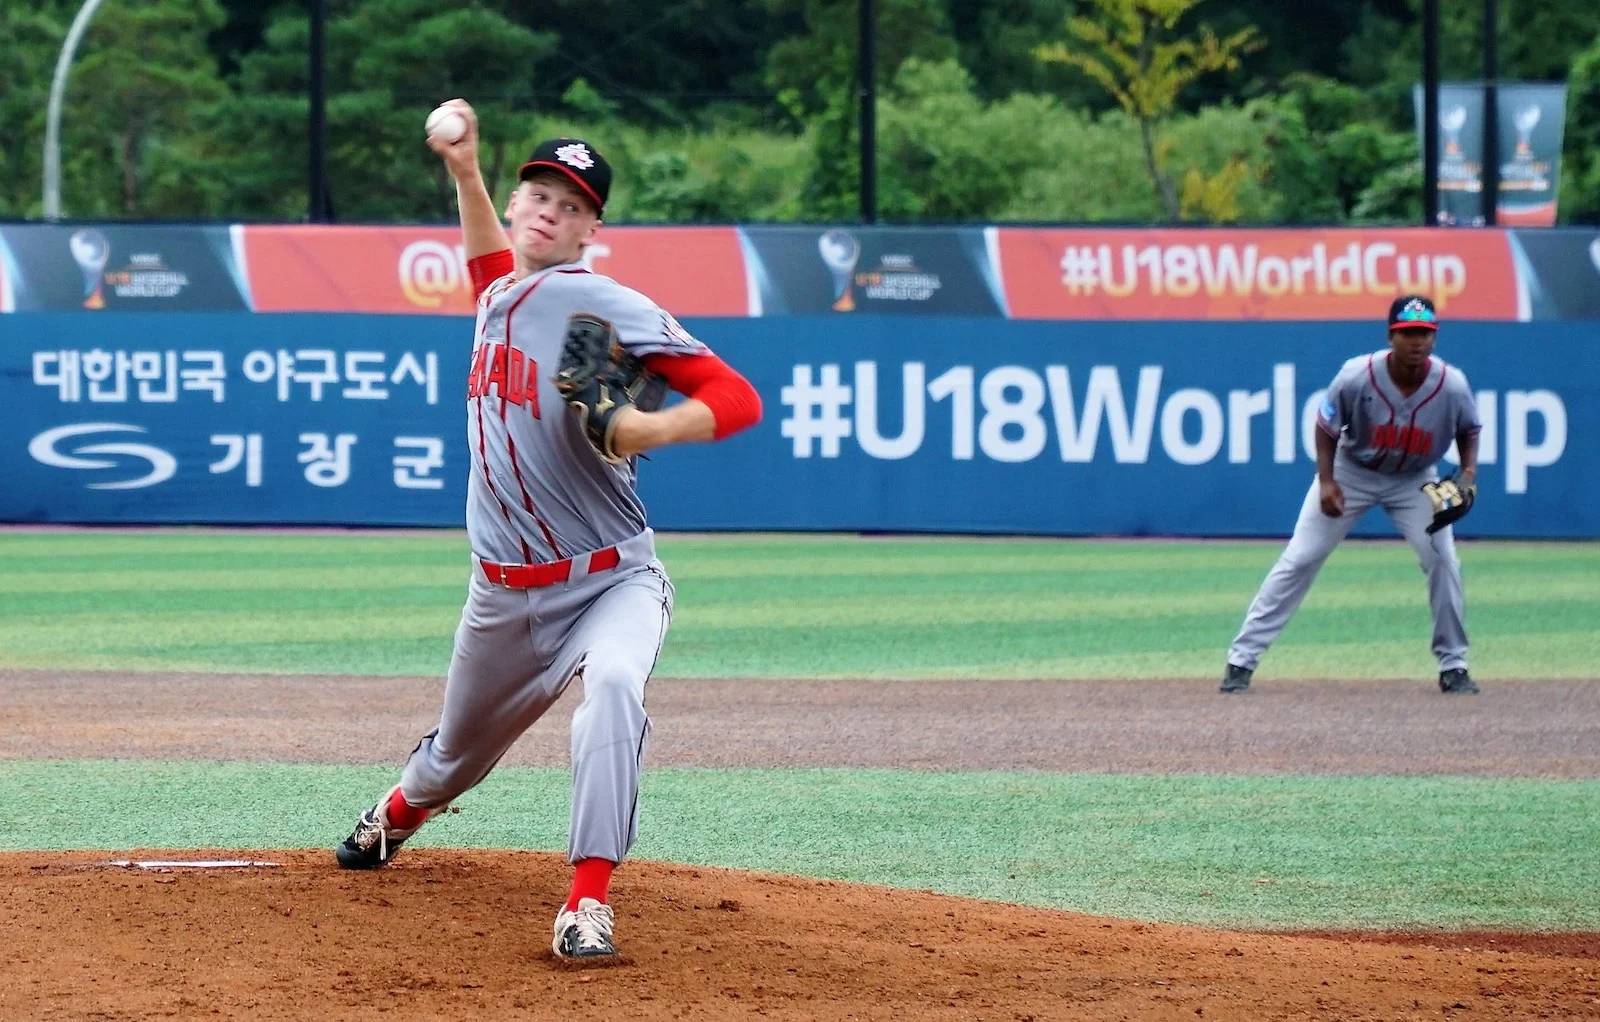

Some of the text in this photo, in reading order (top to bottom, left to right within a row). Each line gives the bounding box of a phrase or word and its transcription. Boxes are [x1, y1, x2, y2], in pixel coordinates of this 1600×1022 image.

[1060, 243, 1467, 309] #U18WorldCup
[32, 349, 438, 404] 대한민국 야구도시
[466, 343, 541, 420] ANADA
[781, 360, 1567, 494] #U18Worlup
